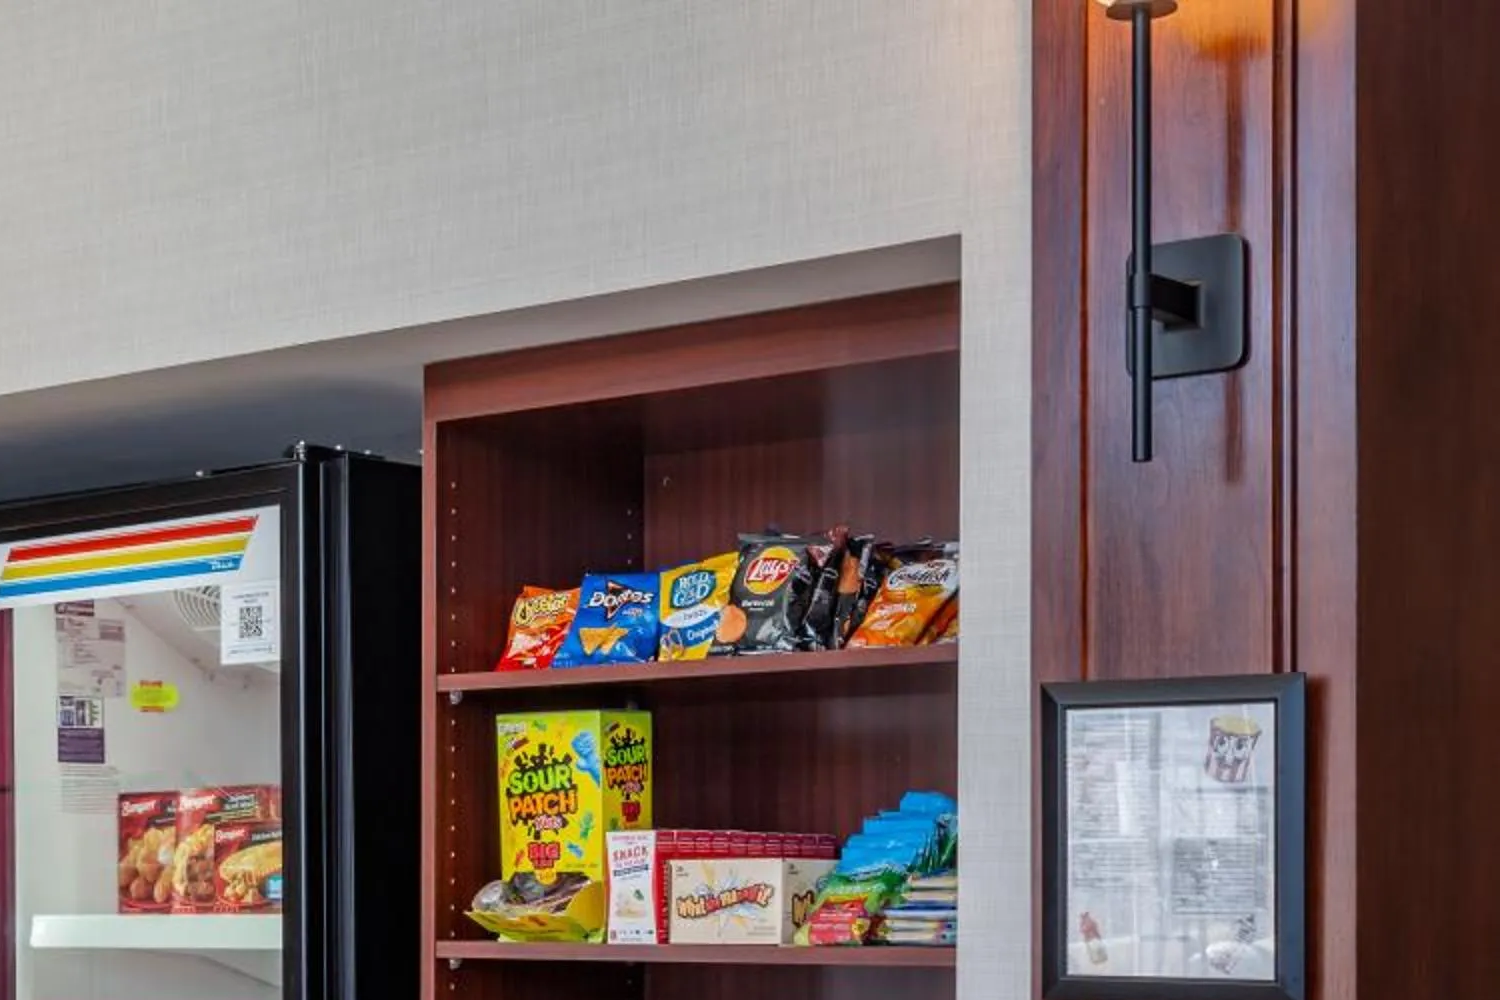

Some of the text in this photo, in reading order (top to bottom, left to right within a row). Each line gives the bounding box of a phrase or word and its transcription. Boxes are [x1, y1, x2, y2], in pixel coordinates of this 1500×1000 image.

[588, 590, 654, 608] Doritos
[606, 745, 646, 766] SOUR
[509, 764, 572, 794] SOUR
[605, 763, 647, 788] PATCH
[508, 790, 577, 822] PATCH
